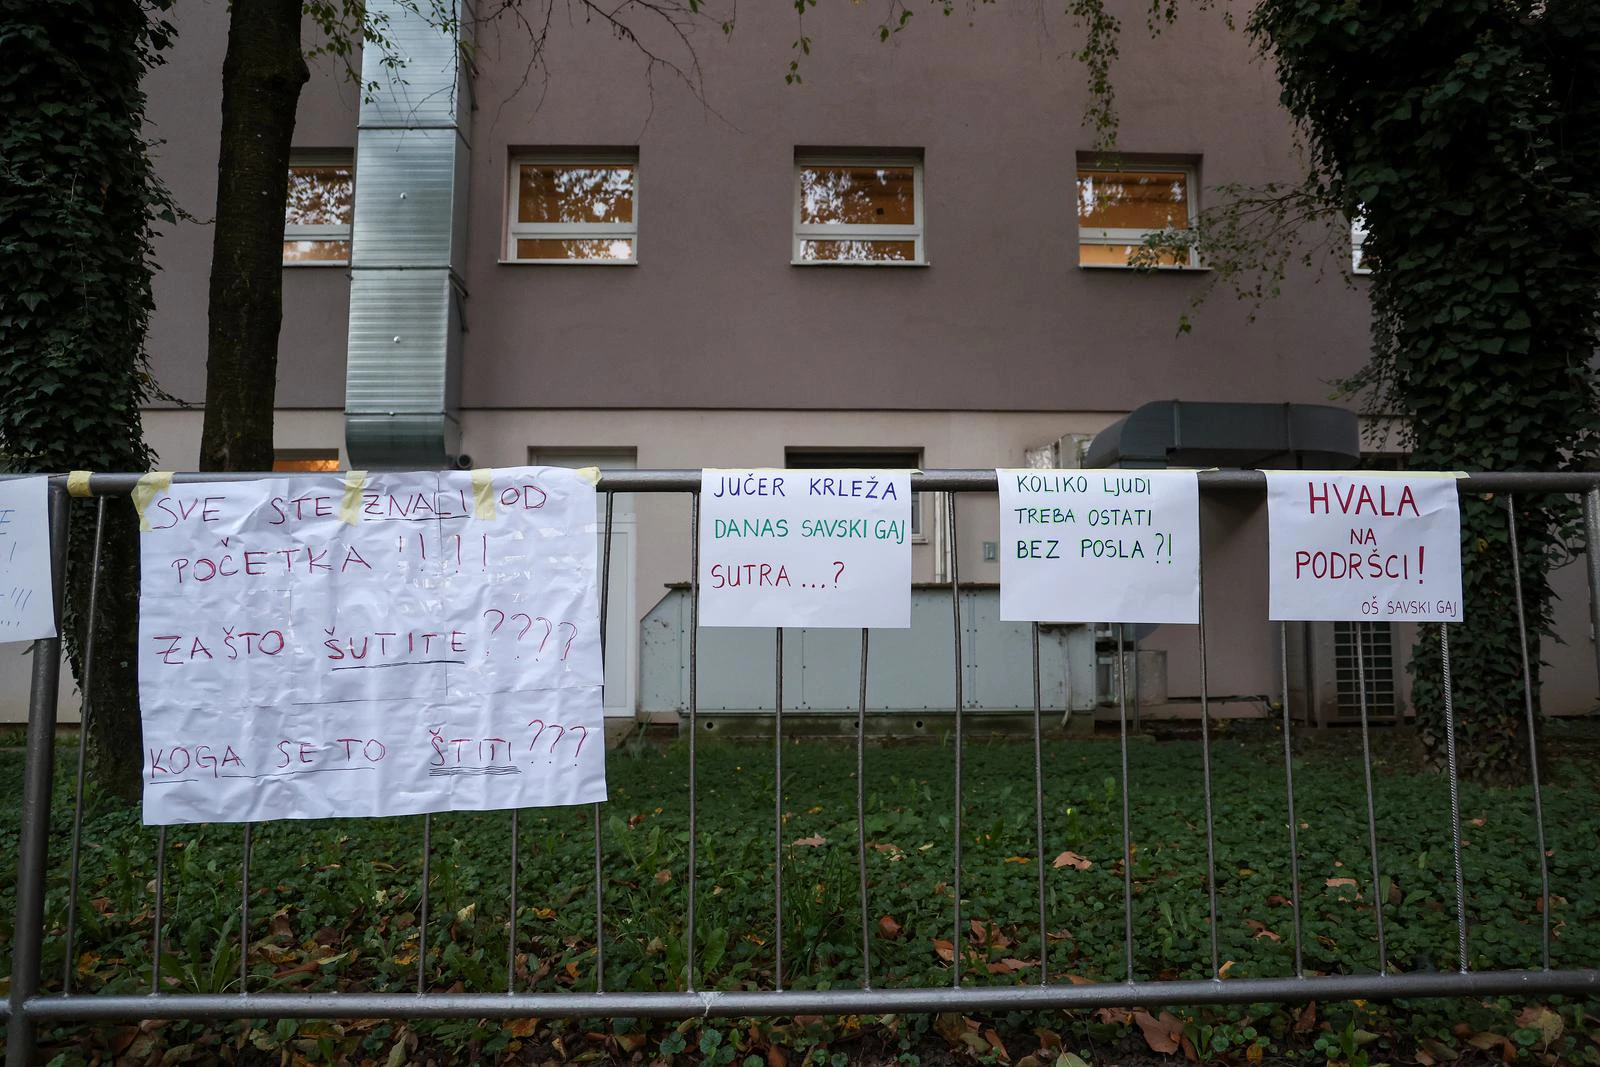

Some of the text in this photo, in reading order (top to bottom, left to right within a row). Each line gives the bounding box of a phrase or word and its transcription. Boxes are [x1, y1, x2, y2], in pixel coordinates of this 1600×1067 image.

[713, 473, 898, 501] JUČER KRLEŽA
[1016, 475, 1151, 497] KOLIKO LJUDI
[1308, 482, 1420, 517] HVALA
[152, 485, 547, 530] SVE STE ZNALI OD
[1014, 508, 1152, 526] TREBA OSTATI
[715, 518, 905, 545] DANAS SAVSKI GAJ
[1350, 527, 1377, 546] NA
[172, 537, 372, 584] POČETKA
[1017, 540, 1060, 559] BEZ
[1361, 595, 1457, 617] OŠ SAVSKI GAJ
[153, 625, 285, 665] ZAŠTO
[150, 744, 246, 779] KOGA
[277, 740, 316, 769] SE
[336, 738, 386, 762] TO
